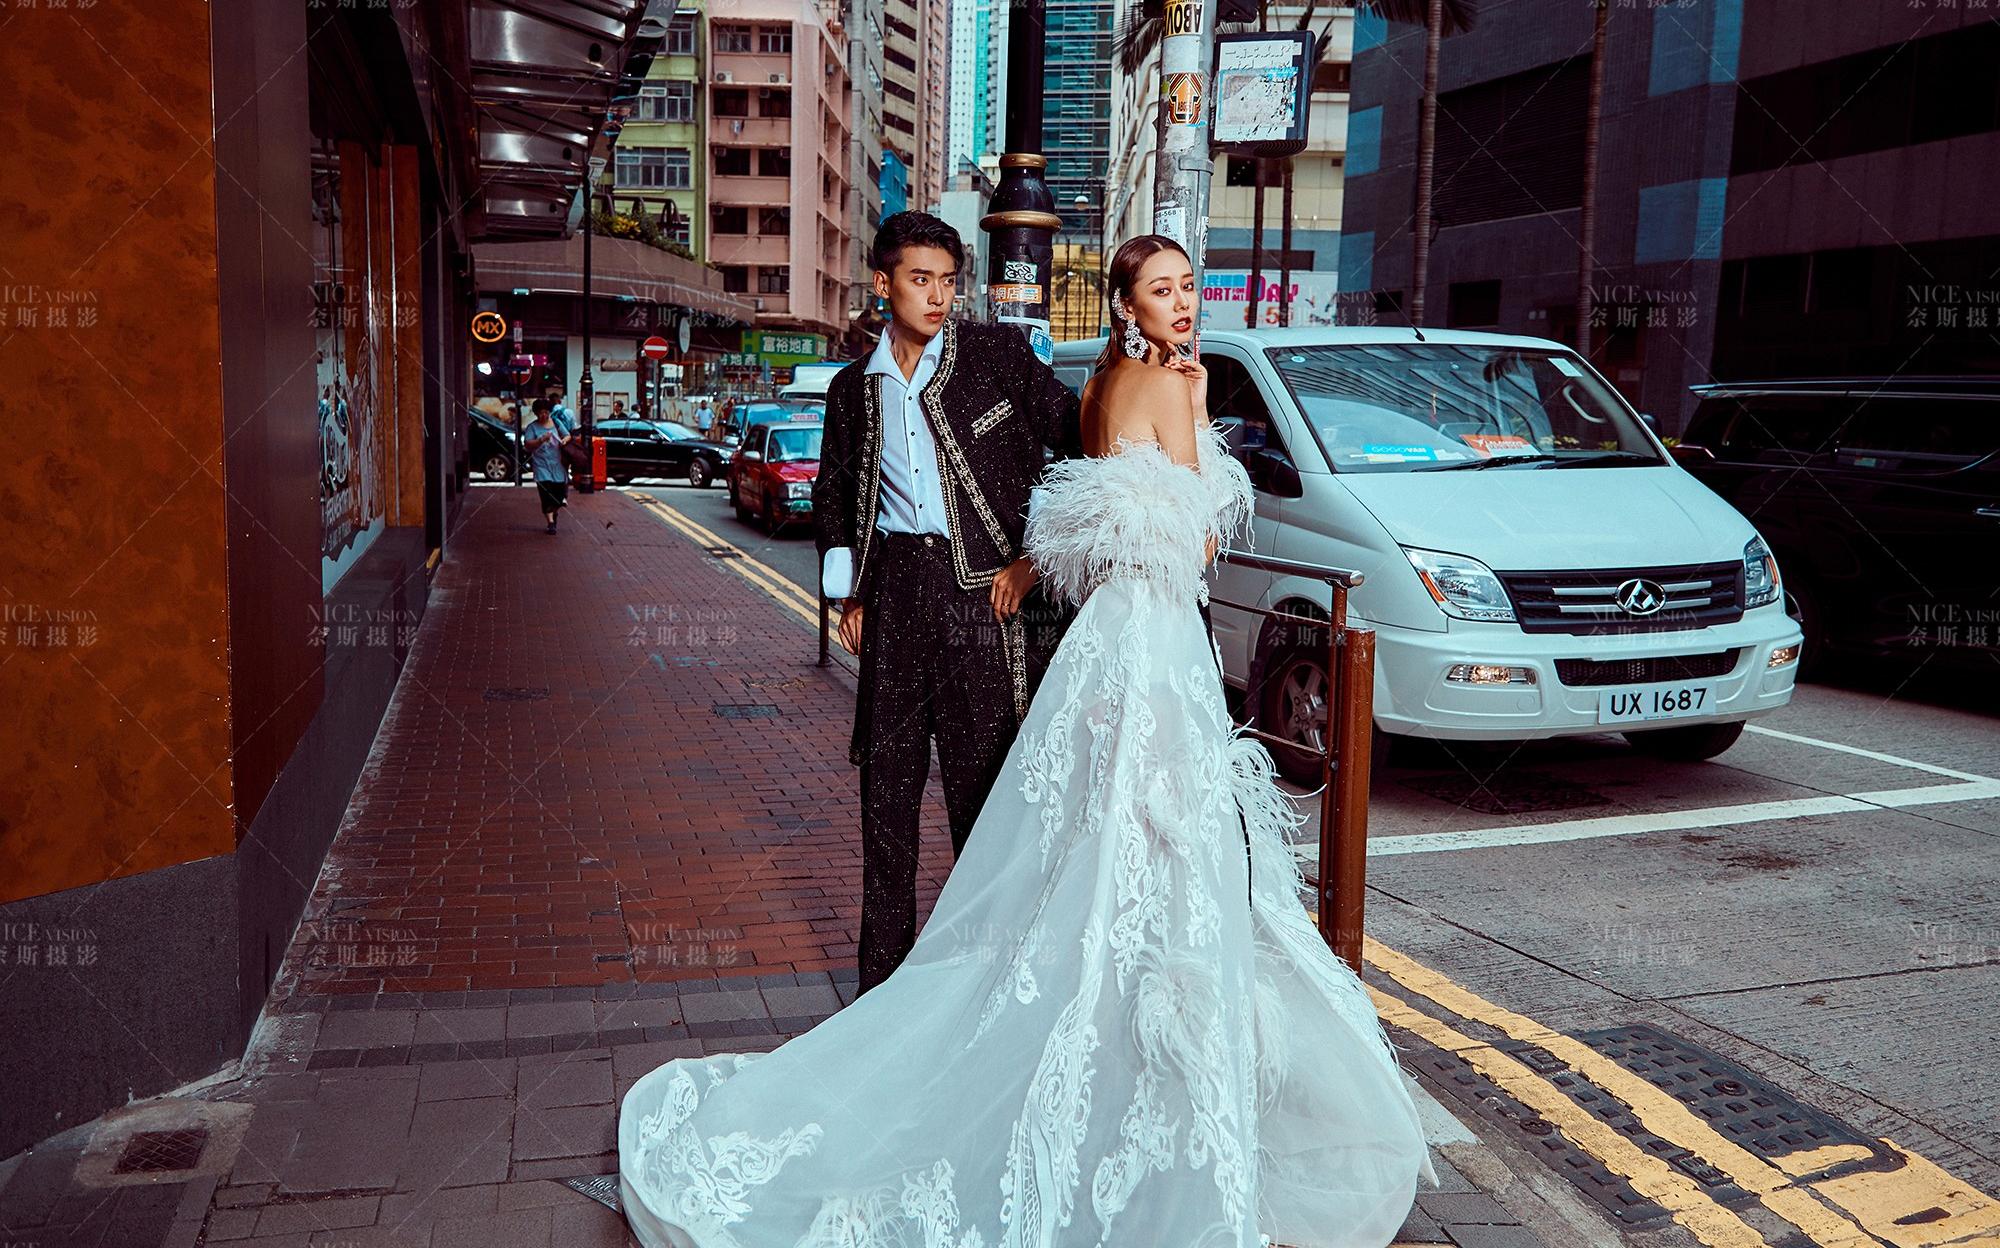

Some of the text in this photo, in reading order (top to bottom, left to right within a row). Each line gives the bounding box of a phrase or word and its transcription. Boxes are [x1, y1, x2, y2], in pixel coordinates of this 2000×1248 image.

[1203, 288, 1231, 302] ORT
[477, 321, 500, 334] MX
[763, 336, 813, 354] 富裕地產
[1610, 687, 1707, 716] UX 1687
